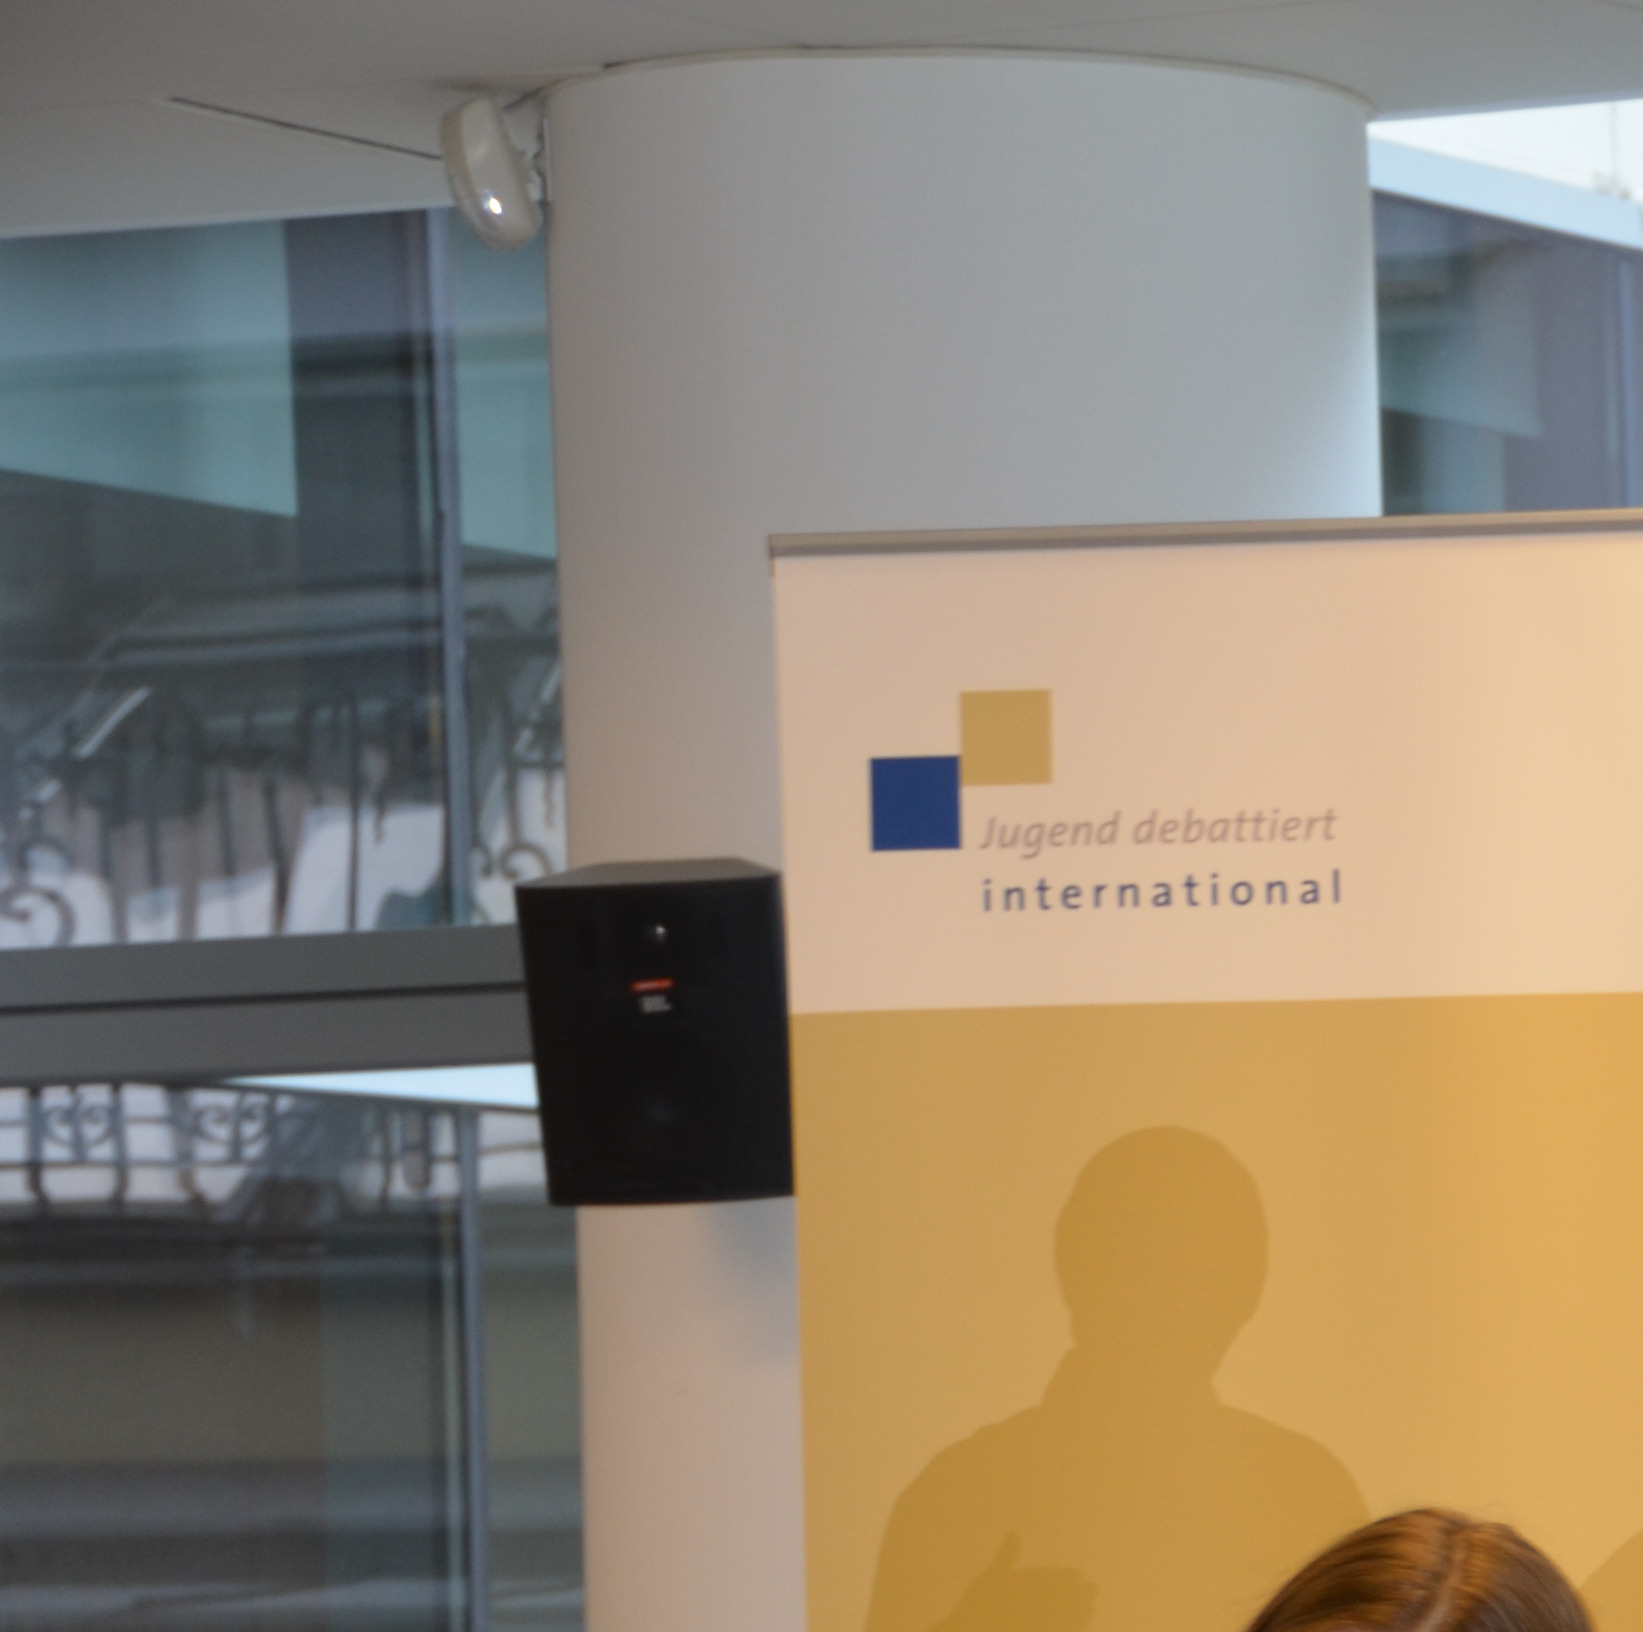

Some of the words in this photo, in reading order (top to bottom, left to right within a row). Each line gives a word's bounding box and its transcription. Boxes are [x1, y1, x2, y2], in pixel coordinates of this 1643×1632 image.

[979, 810, 1123, 861] Jugend
[1131, 807, 1339, 846] debattiert
[981, 869, 1342, 913] international
